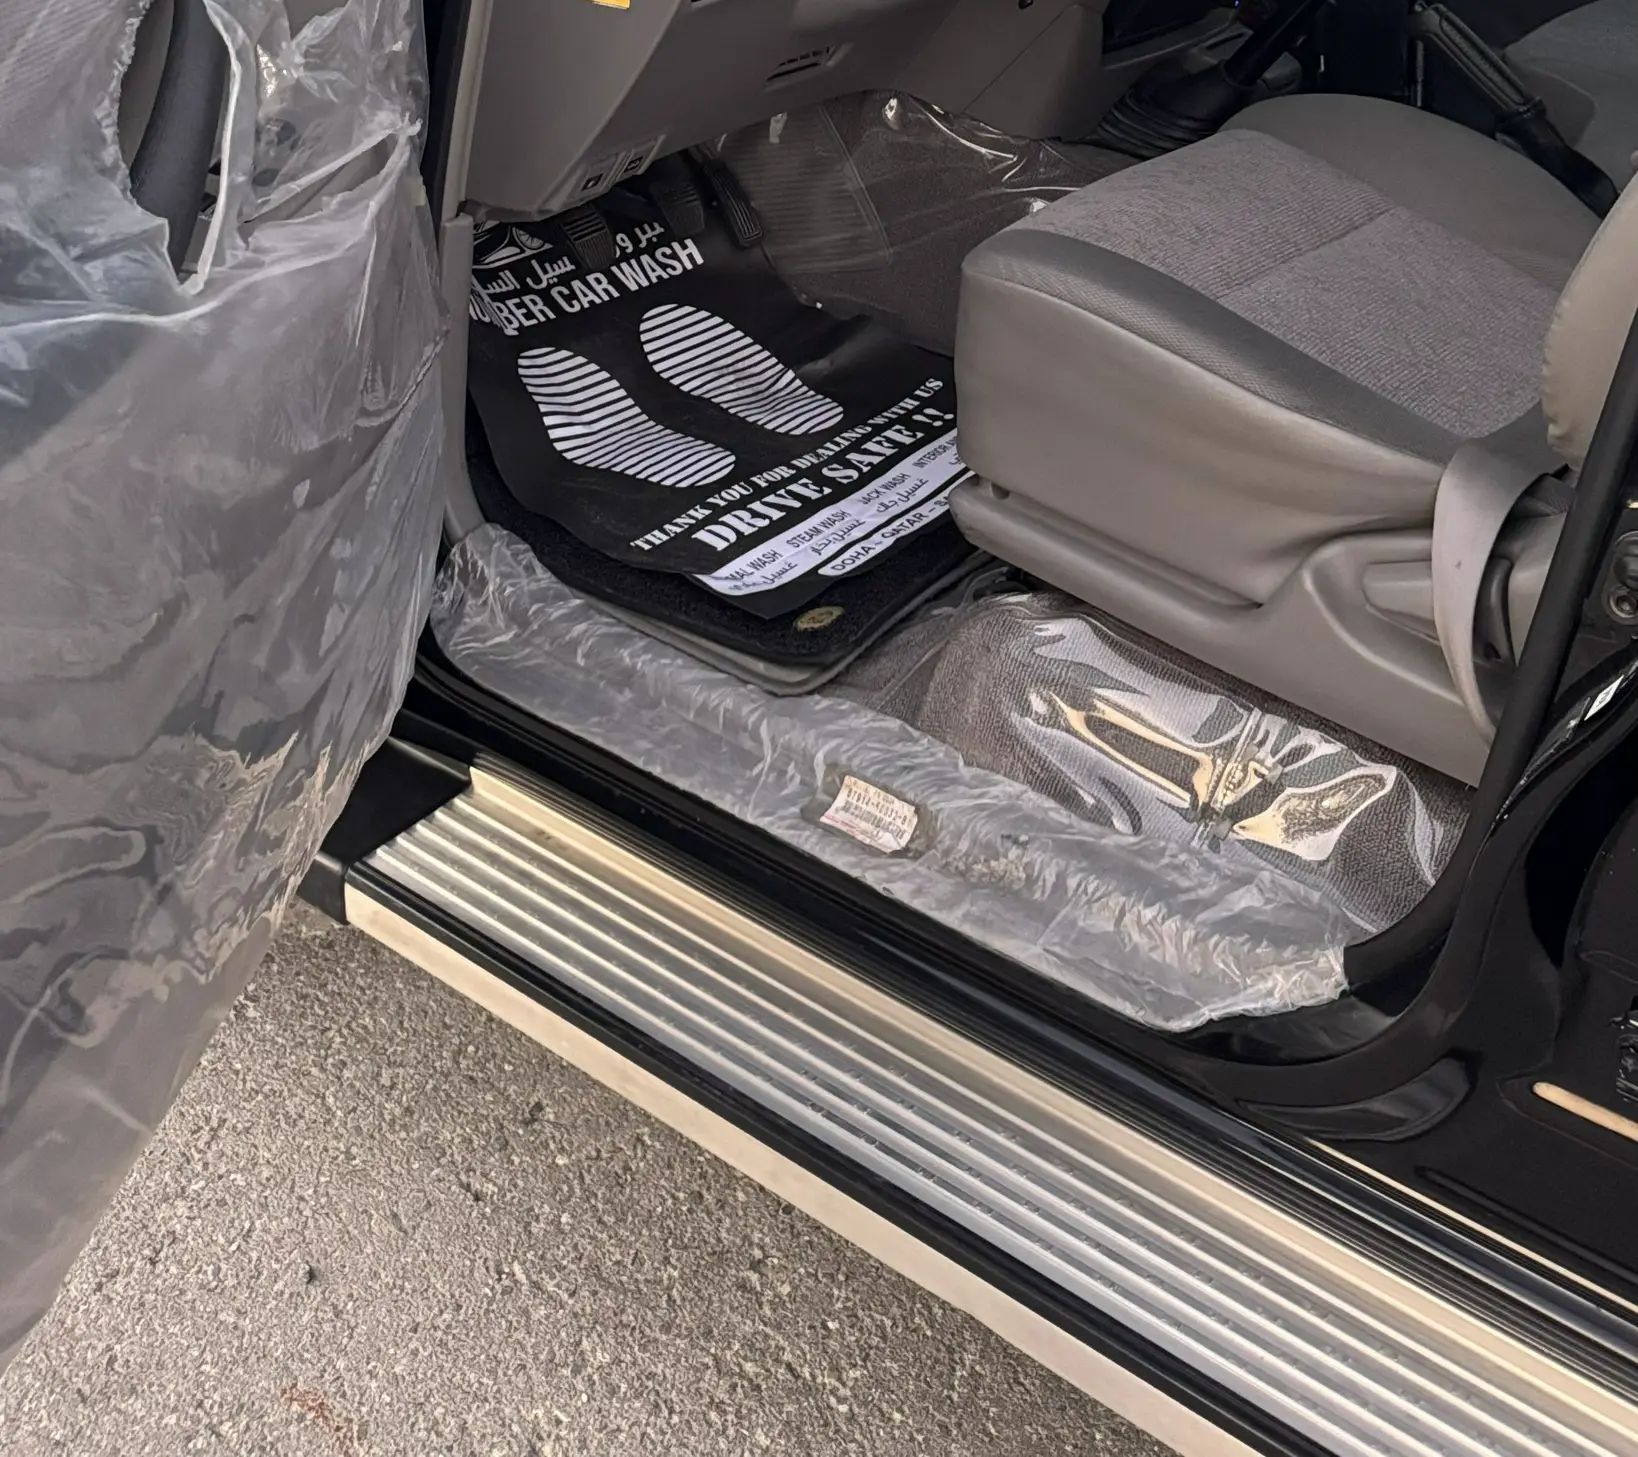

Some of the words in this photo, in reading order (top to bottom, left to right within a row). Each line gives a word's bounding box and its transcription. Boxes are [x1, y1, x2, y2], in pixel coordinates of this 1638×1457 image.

[550, 272, 621, 313] CAR
[610, 238, 705, 292] WASH
[629, 504, 713, 552] THANK
[705, 482, 754, 507] YOU
[750, 464, 796, 488] FOR
[791, 424, 872, 470] DEALING
[867, 396, 921, 426] WITH
[913, 378, 944, 399] US
[691, 477, 833, 552] DRIVE
[821, 424, 925, 485] SAFE
[912, 407, 955, 427] !!
[880, 472, 912, 494] WASH
[898, 478, 930, 503] غسيل
[786, 525, 823, 549] STEAM
[821, 509, 853, 531] WASH
[831, 545, 877, 572] DOHA
[881, 512, 930, 539] QATAR
[750, 549, 784, 572] WASH
